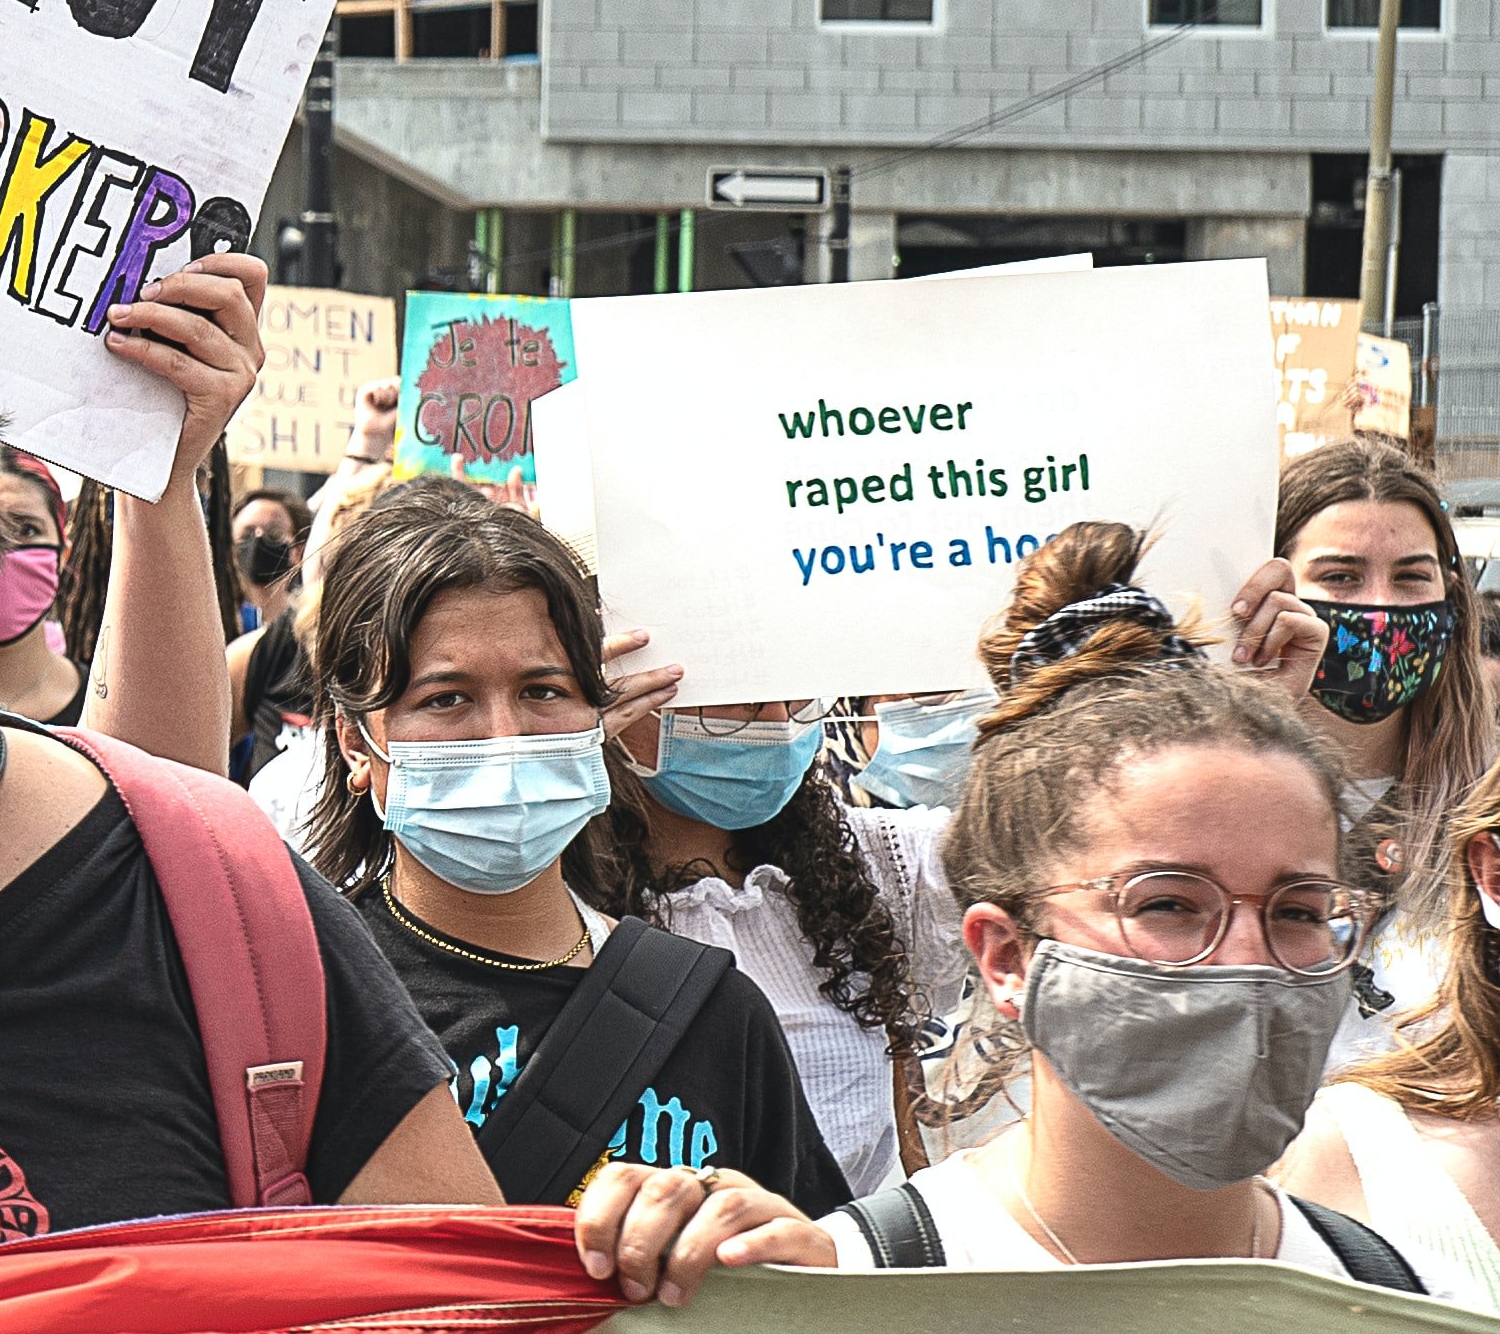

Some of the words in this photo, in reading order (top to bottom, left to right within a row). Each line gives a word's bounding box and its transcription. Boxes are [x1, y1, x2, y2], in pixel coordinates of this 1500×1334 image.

[259, 300, 376, 344] OMEN
[431, 318, 478, 369] Je
[504, 316, 544, 369] te
[264, 342, 361, 378] ON'T
[413, 392, 534, 455] CROI
[777, 398, 974, 440] whoever
[785, 462, 915, 515] raped
[927, 458, 1008, 500] this
[1023, 452, 1091, 504] girl
[792, 532, 935, 587] you're
[948, 538, 973, 567] a
